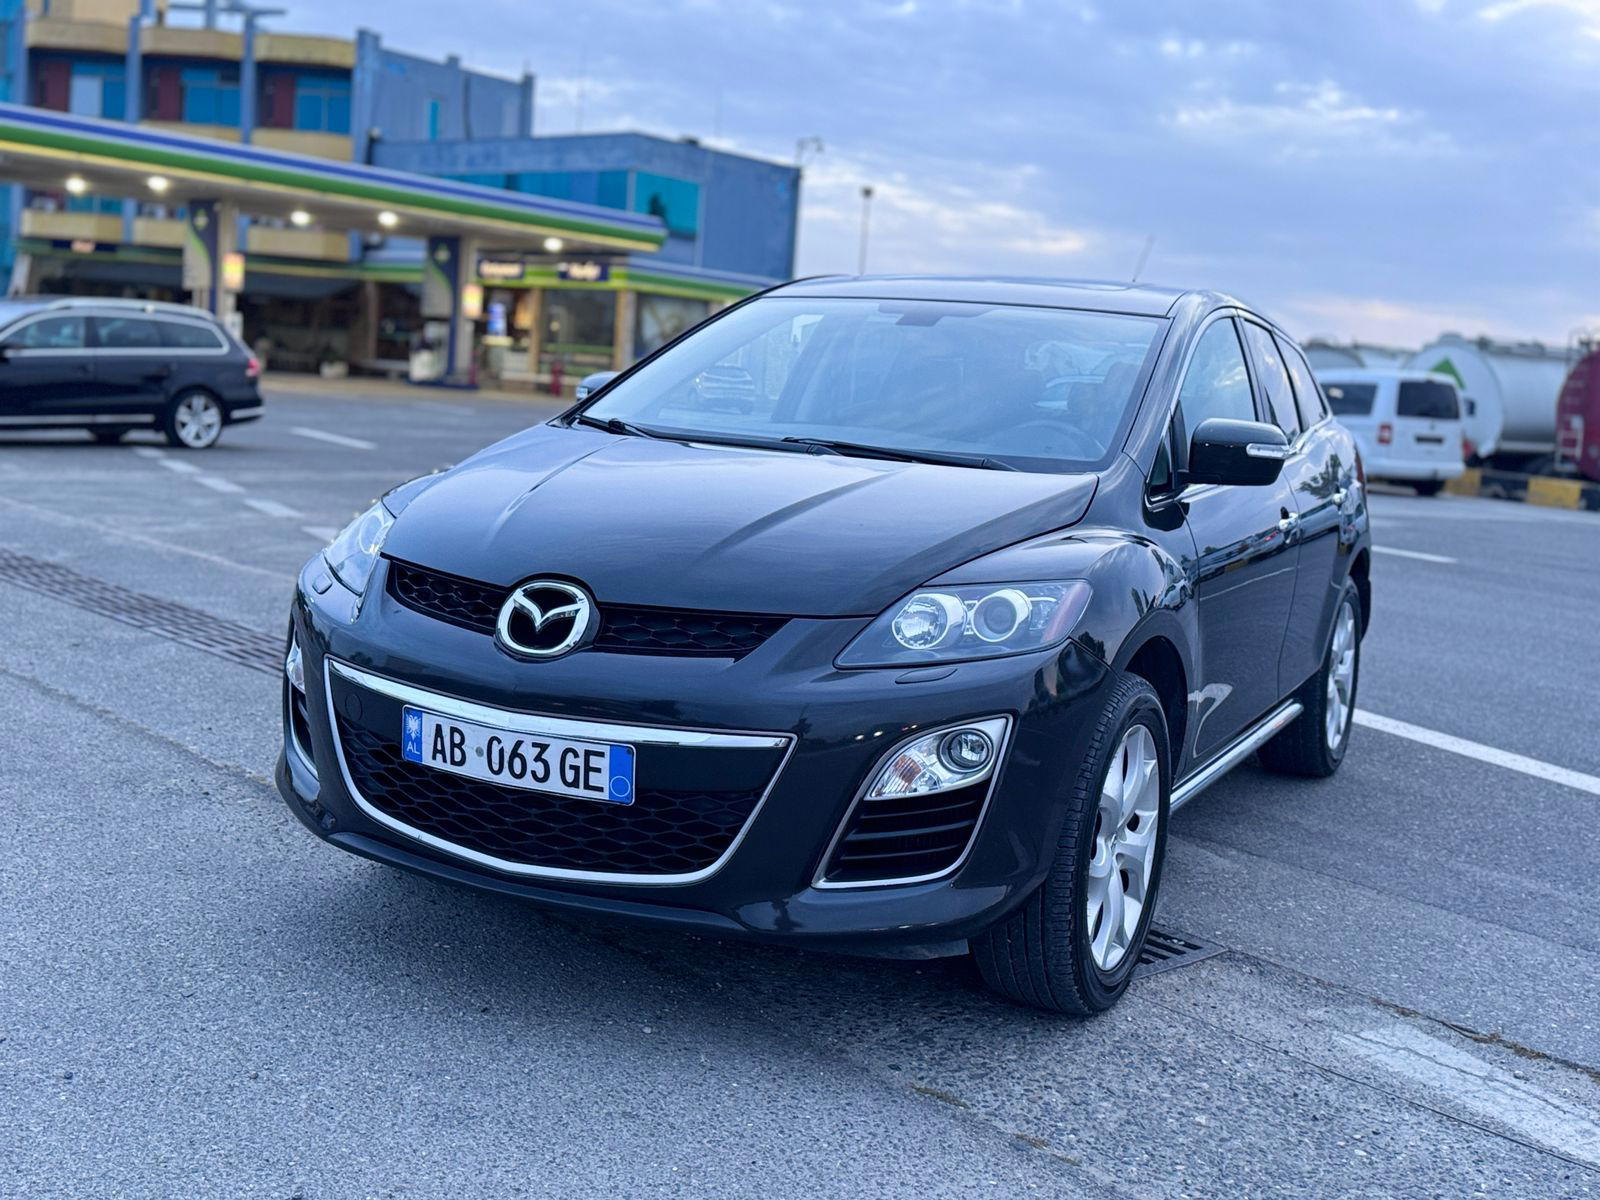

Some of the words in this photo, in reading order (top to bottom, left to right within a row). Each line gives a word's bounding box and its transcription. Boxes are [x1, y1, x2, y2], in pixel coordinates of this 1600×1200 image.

[406, 740, 421, 755] AL
[432, 723, 467, 767] AB
[486, 735, 551, 784] 063
[559, 747, 606, 793] GE
